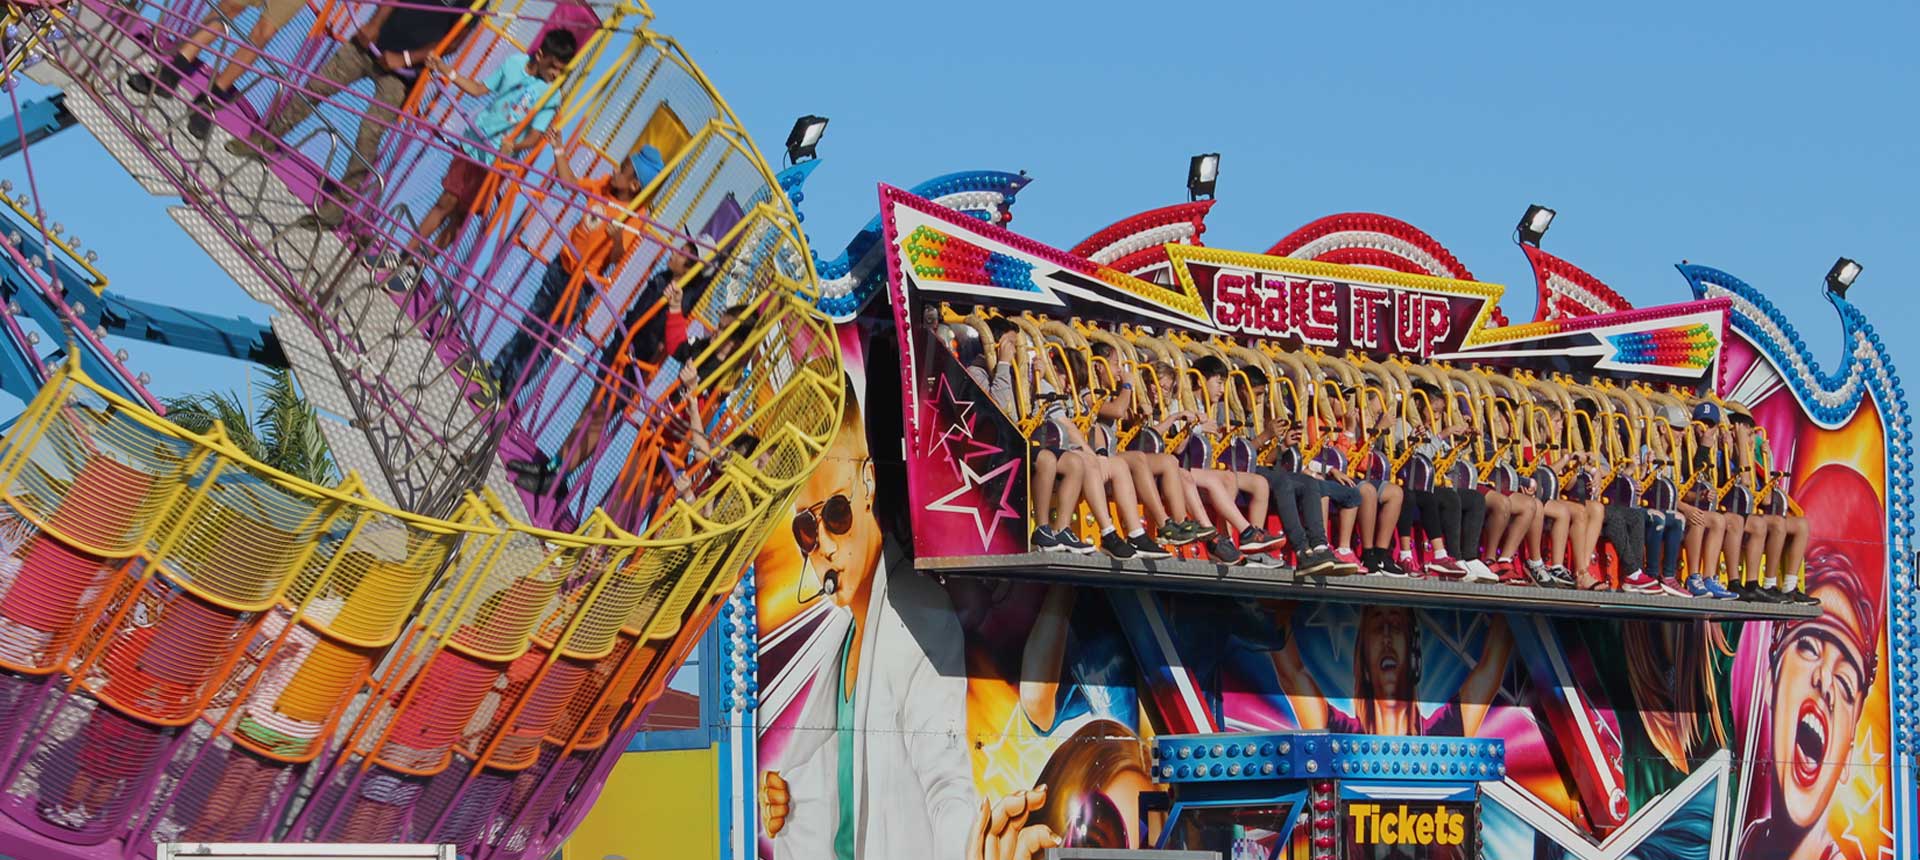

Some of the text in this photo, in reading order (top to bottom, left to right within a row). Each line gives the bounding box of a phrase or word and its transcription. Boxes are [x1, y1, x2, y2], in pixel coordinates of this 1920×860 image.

[1350, 286, 1391, 347] IT
[1395, 290, 1450, 359] UP
[1703, 404, 1711, 414] B
[1349, 804, 1465, 846] Tickets
